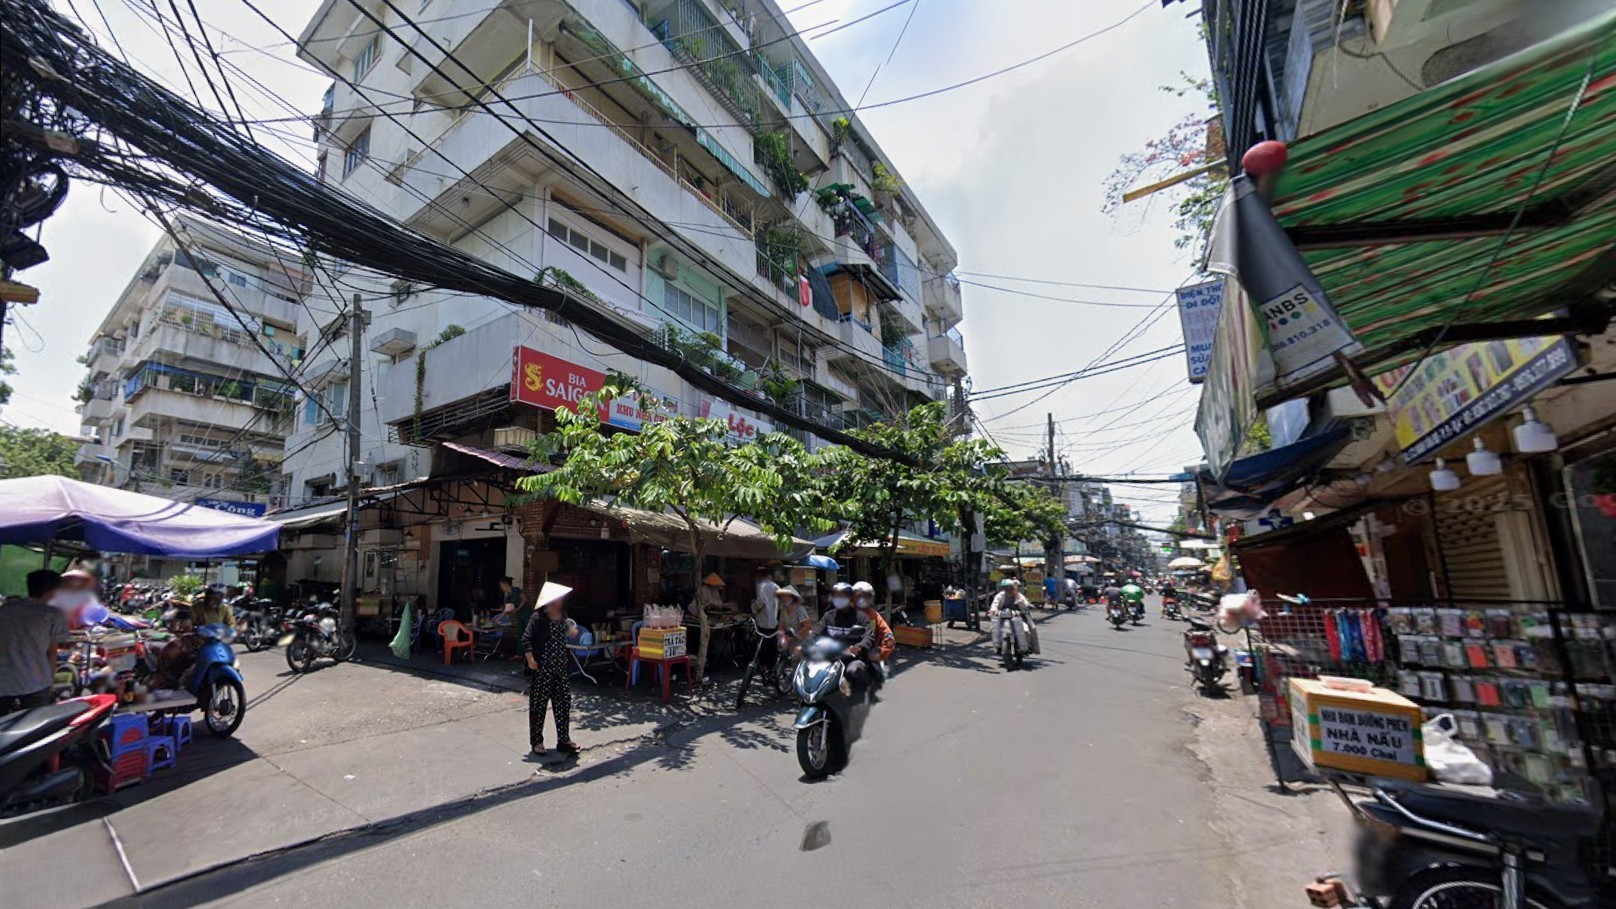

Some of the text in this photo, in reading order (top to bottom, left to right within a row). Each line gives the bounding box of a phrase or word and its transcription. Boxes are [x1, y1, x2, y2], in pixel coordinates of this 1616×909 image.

[568, 372, 587, 388] BIA
[617, 403, 634, 417] KHU
[728, 413, 754, 438] Lộc
[1371, 747, 1397, 761] Chai
